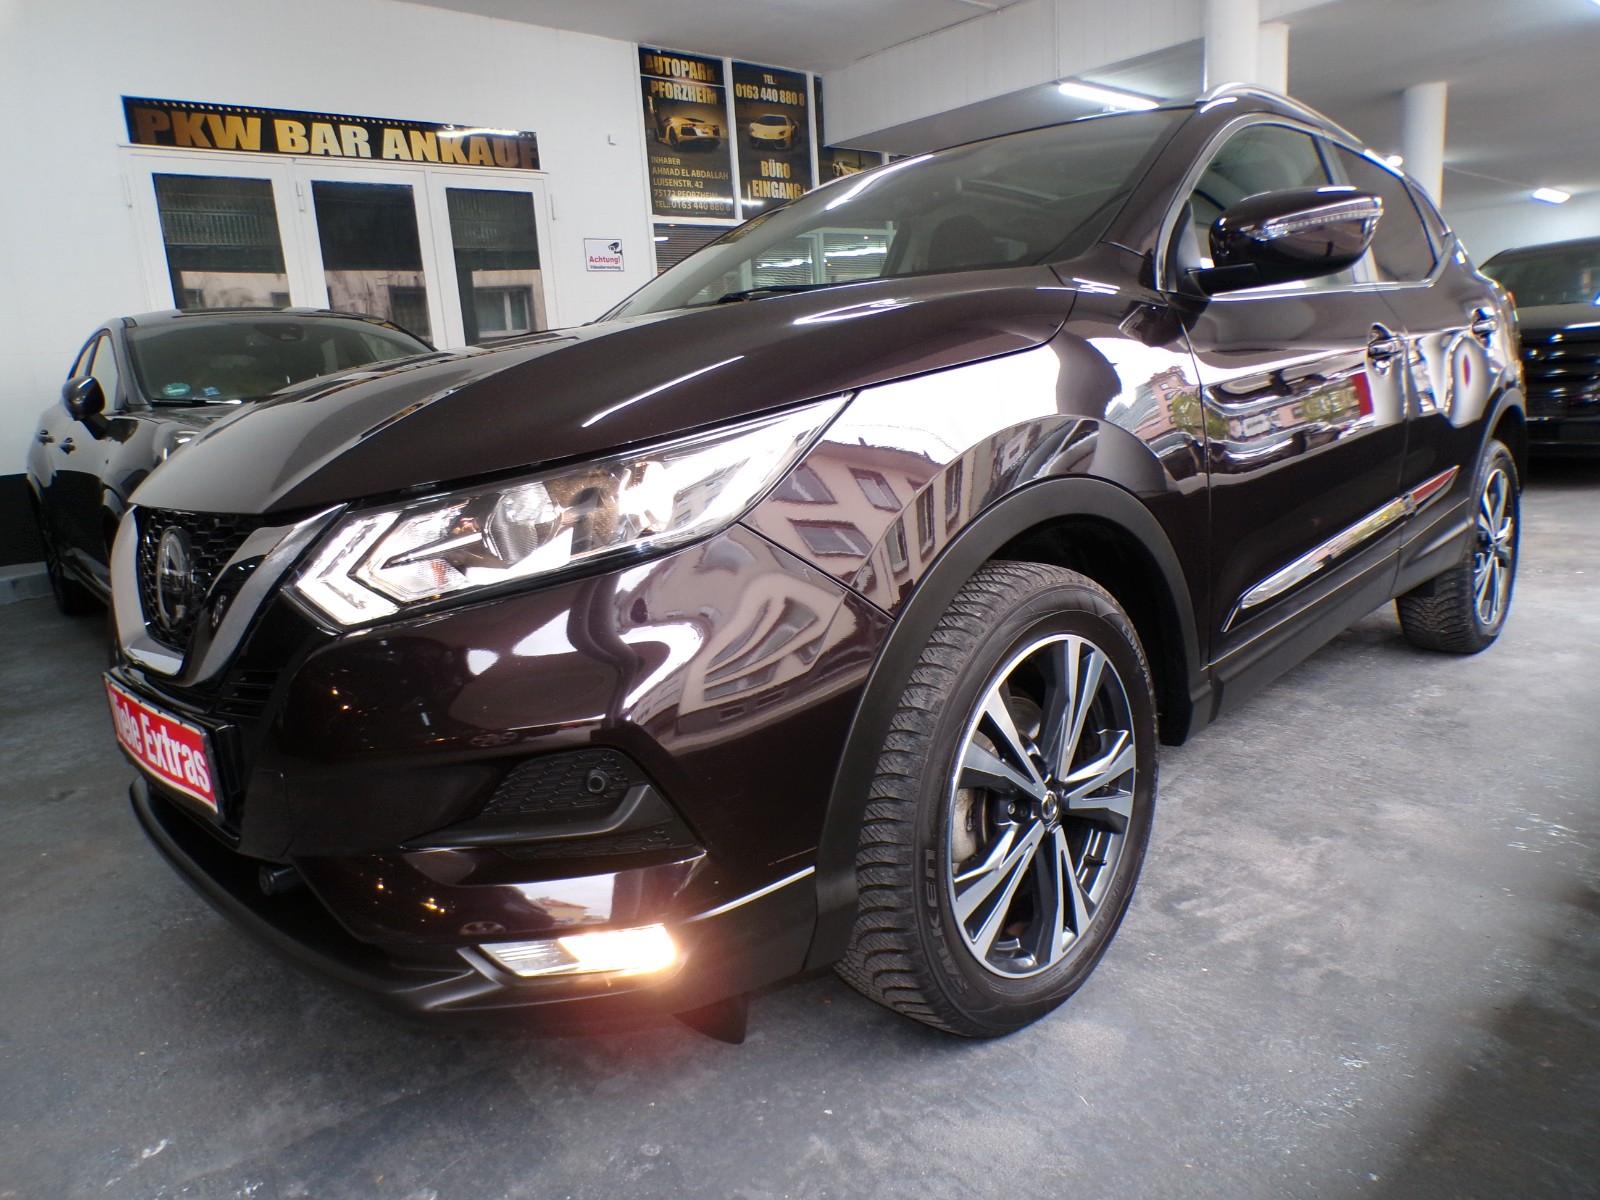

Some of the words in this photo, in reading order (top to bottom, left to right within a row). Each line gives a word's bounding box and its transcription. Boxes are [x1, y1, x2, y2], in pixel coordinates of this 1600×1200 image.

[650, 80, 717, 105] PFORZHEIM
[735, 83, 759, 100] 0163
[760, 87, 778, 103] 440
[780, 89, 797, 105] 880
[132, 107, 261, 151] PKW
[274, 119, 372, 158] BAR
[382, 128, 539, 170] ANKAUF
[651, 156, 681, 166] INHABER
[761, 158, 791, 179] BÜRO
[652, 167, 680, 177] AHMAD
[681, 168, 690, 177] EL
[691, 169, 729, 181] ABDALLAH
[653, 178, 694, 188] LUISENSTR.
[694, 181, 705, 189] 42
[752, 179, 802, 201] EINGANG
[671, 201, 693, 210] 0163
[693, 202, 709, 211] 440
[589, 255, 621, 265] Achtung!
[139, 713, 211, 793] Extras
